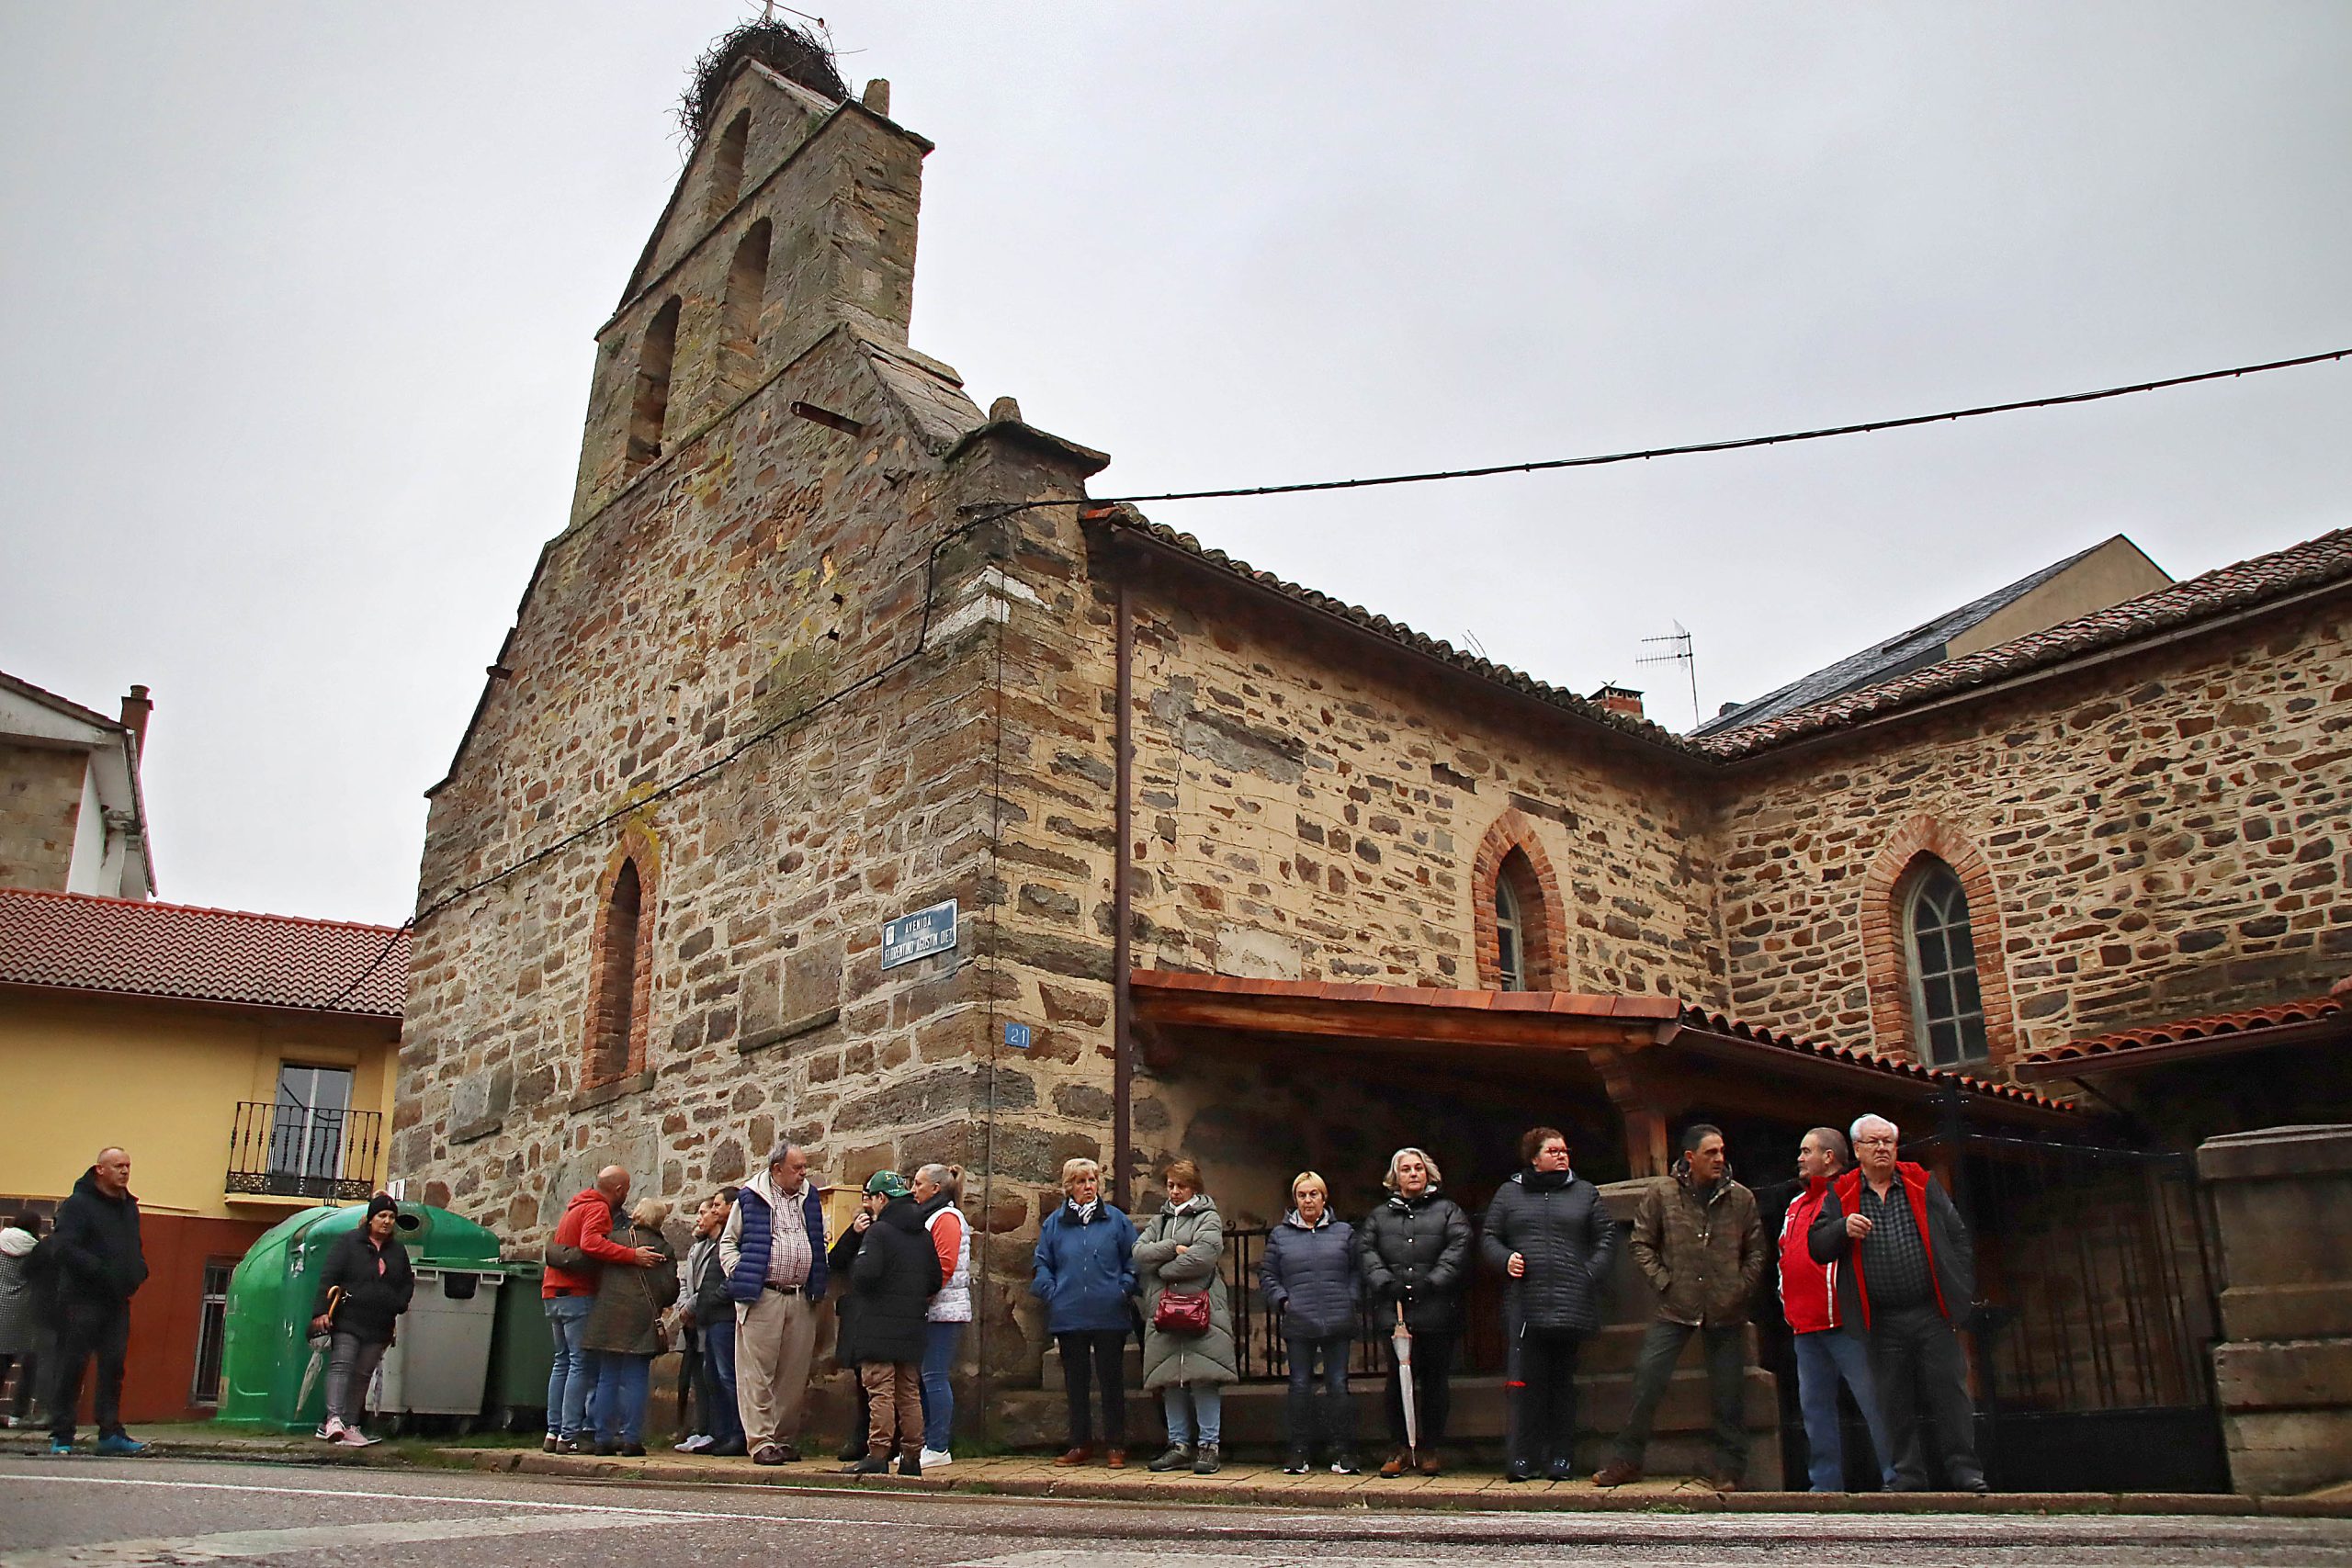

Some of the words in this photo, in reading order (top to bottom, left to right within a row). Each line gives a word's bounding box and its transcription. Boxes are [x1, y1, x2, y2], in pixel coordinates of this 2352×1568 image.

[905, 915, 932, 934] AVENIDA
[885, 940, 914, 963] FLORENTINO
[940, 927, 953, 944] DIEZ
[1011, 1028, 1025, 1044] 21
